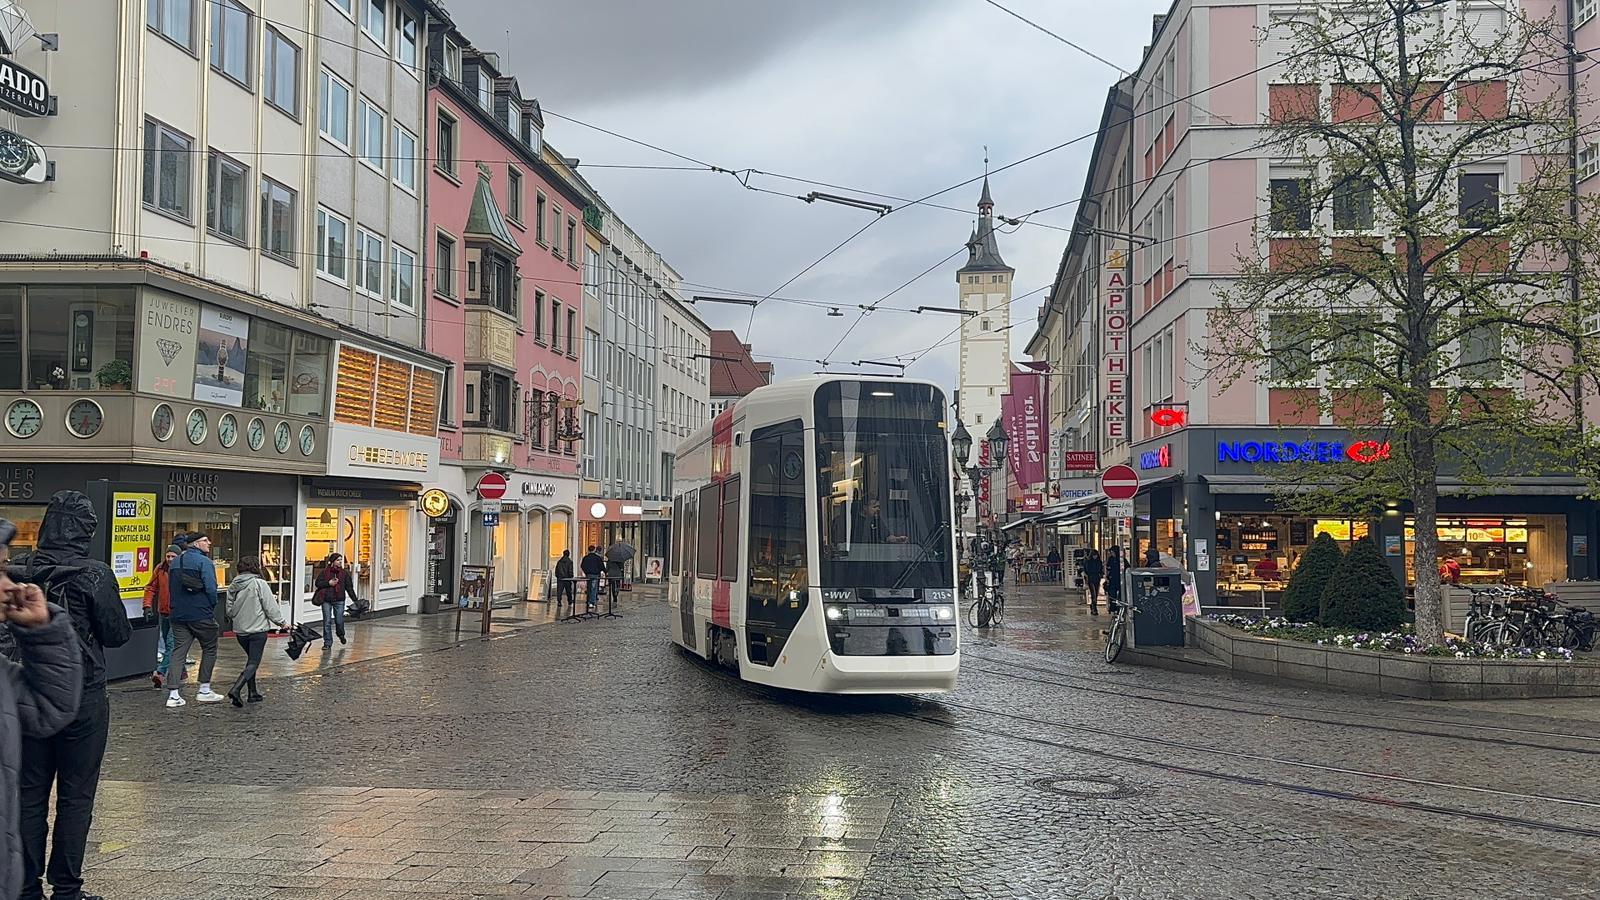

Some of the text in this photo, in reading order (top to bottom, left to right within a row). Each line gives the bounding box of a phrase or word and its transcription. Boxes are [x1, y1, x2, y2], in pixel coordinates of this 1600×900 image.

[150, 299, 194, 317] JUWELIER
[148, 311, 192, 334] ENDRES
[1109, 273, 1124, 436] APOTHEKE
[1218, 440, 1344, 462] NORDSEE
[0, 468, 34, 479] IER
[169, 471, 219, 484] JUWELIER
[168, 485, 218, 501] ENDRES
[1061, 489, 1093, 498] POTHEKE
[114, 525, 137, 533] EINFACH
[114, 534, 151, 542] RICHTIGE RAD
[830, 591, 851, 599] WVV
[932, 591, 946, 599] 215
